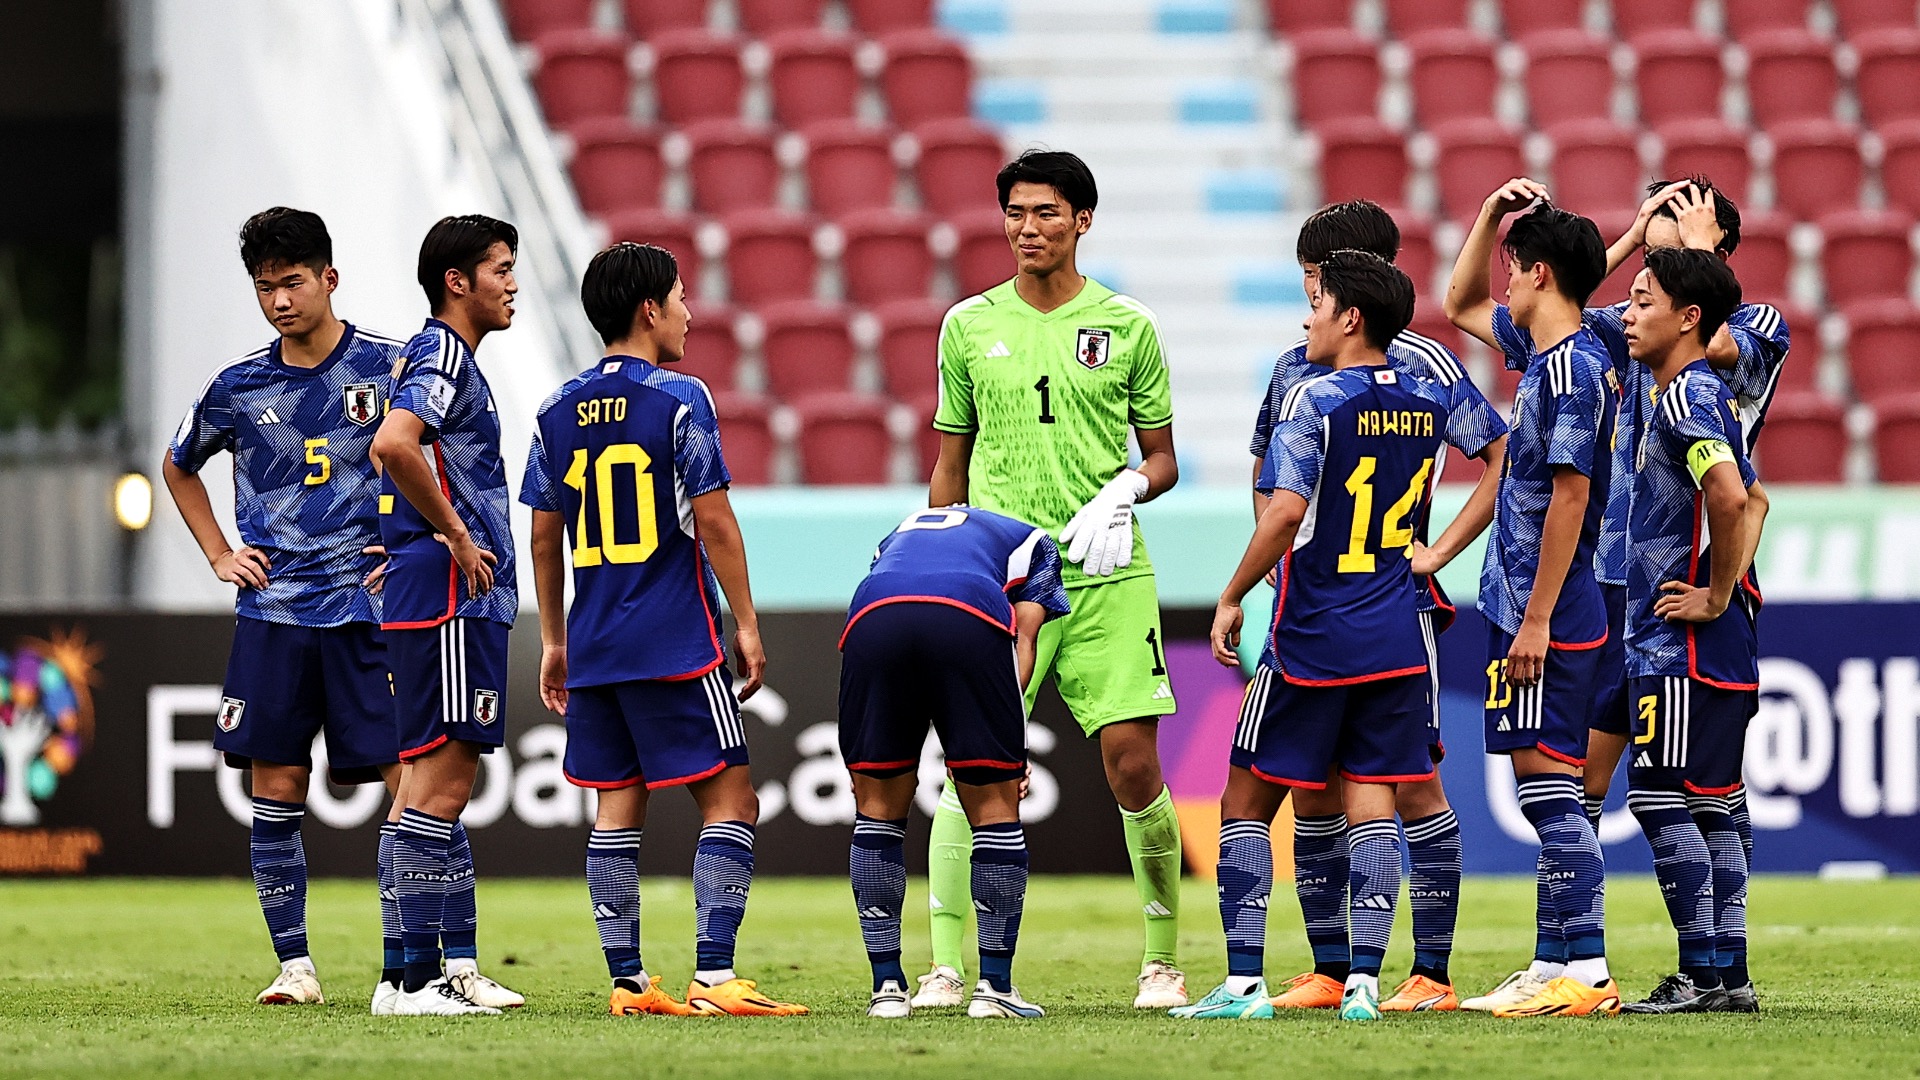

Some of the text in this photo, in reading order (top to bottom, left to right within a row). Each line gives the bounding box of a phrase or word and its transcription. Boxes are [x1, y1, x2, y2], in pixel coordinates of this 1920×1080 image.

[577, 396, 627, 427] SATO
[1034, 375, 1055, 424] 1
[1357, 410, 1434, 437] NAWATA
[303, 437, 331, 486] 5
[562, 443, 659, 569] 10
[1337, 456, 1434, 573] 14
[1145, 627, 1166, 677] 1
[1634, 694, 1658, 745] 3
